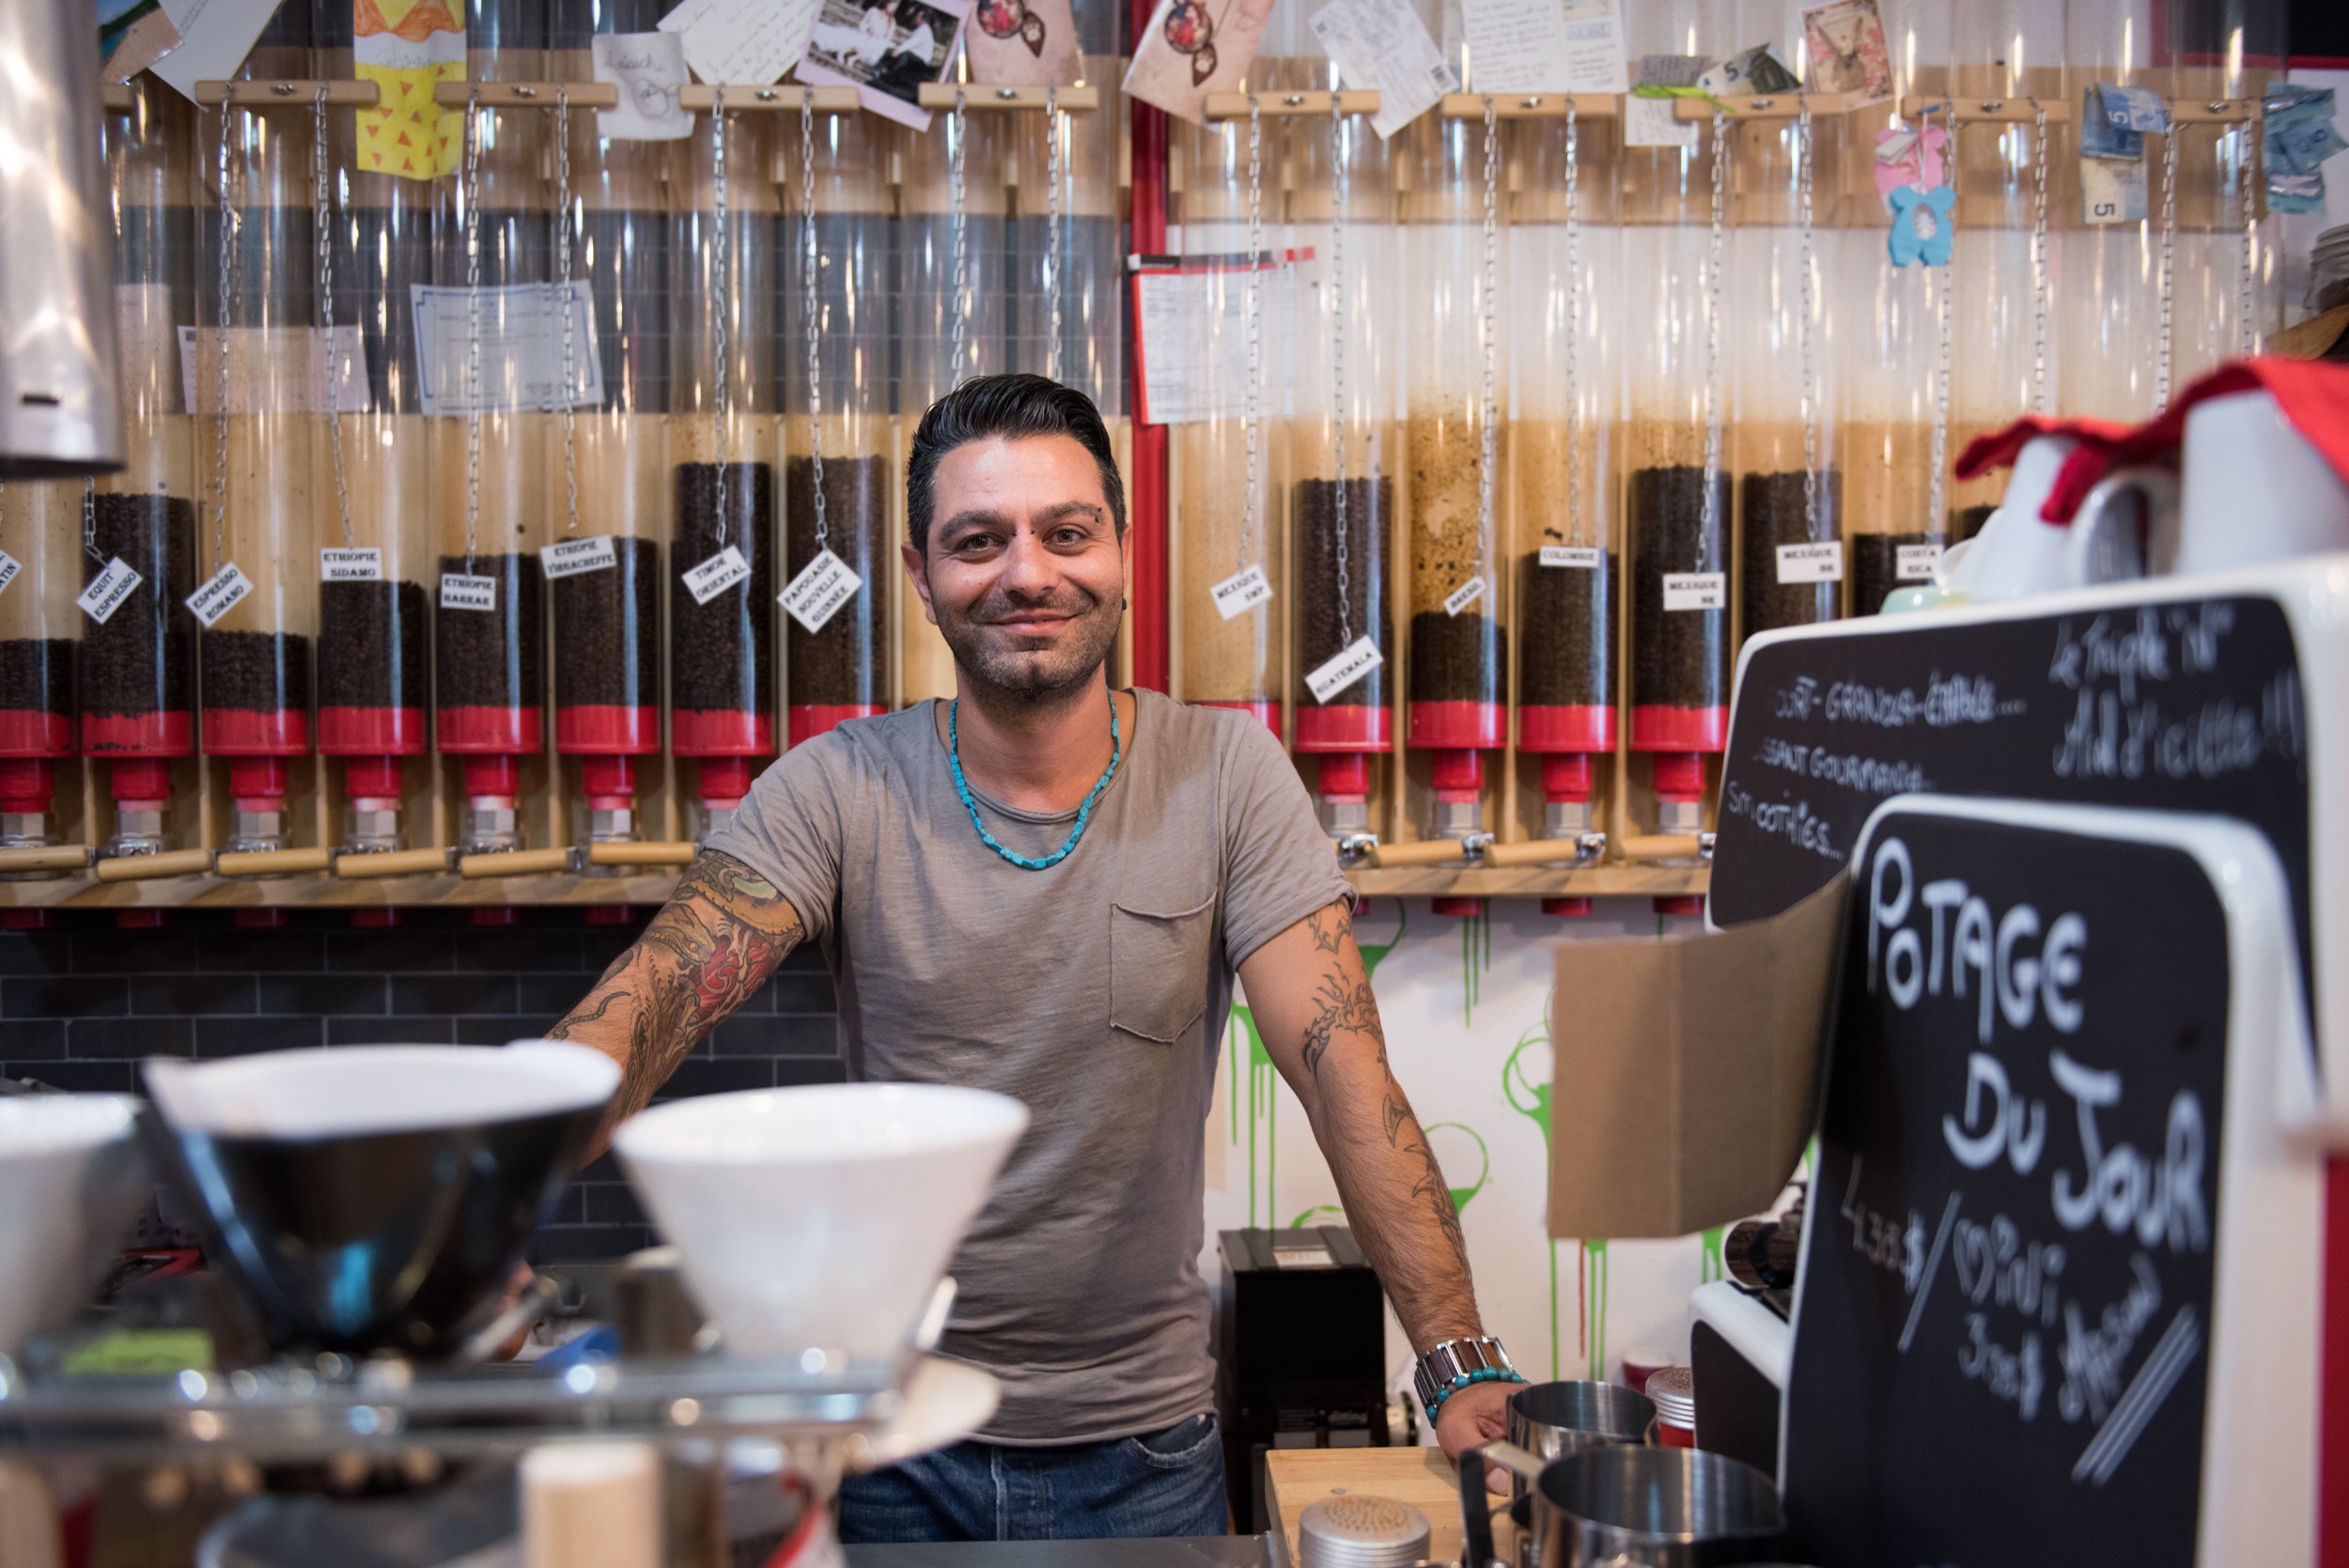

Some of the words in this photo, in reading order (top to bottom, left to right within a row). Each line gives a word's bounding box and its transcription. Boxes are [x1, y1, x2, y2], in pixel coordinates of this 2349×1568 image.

[323, 551, 378, 563] ETHIOPIE
[554, 539, 599, 558] ETHIOPIE
[330, 567, 377, 579] SIDAMO
[443, 578, 493, 591] ETHIOPIE
[694, 556, 728, 581] TIMOR
[695, 565, 747, 598] ORIENTAL
[784, 555, 834, 606] PAPOUASIE
[87, 570, 115, 601] EQUIT
[94, 571, 137, 619] ESPRESSO
[193, 568, 239, 610] ESPRESSO
[798, 569, 843, 616] NOUVELLE
[206, 584, 245, 621] ROMANO
[1315, 650, 1373, 695] GUATEMALA
